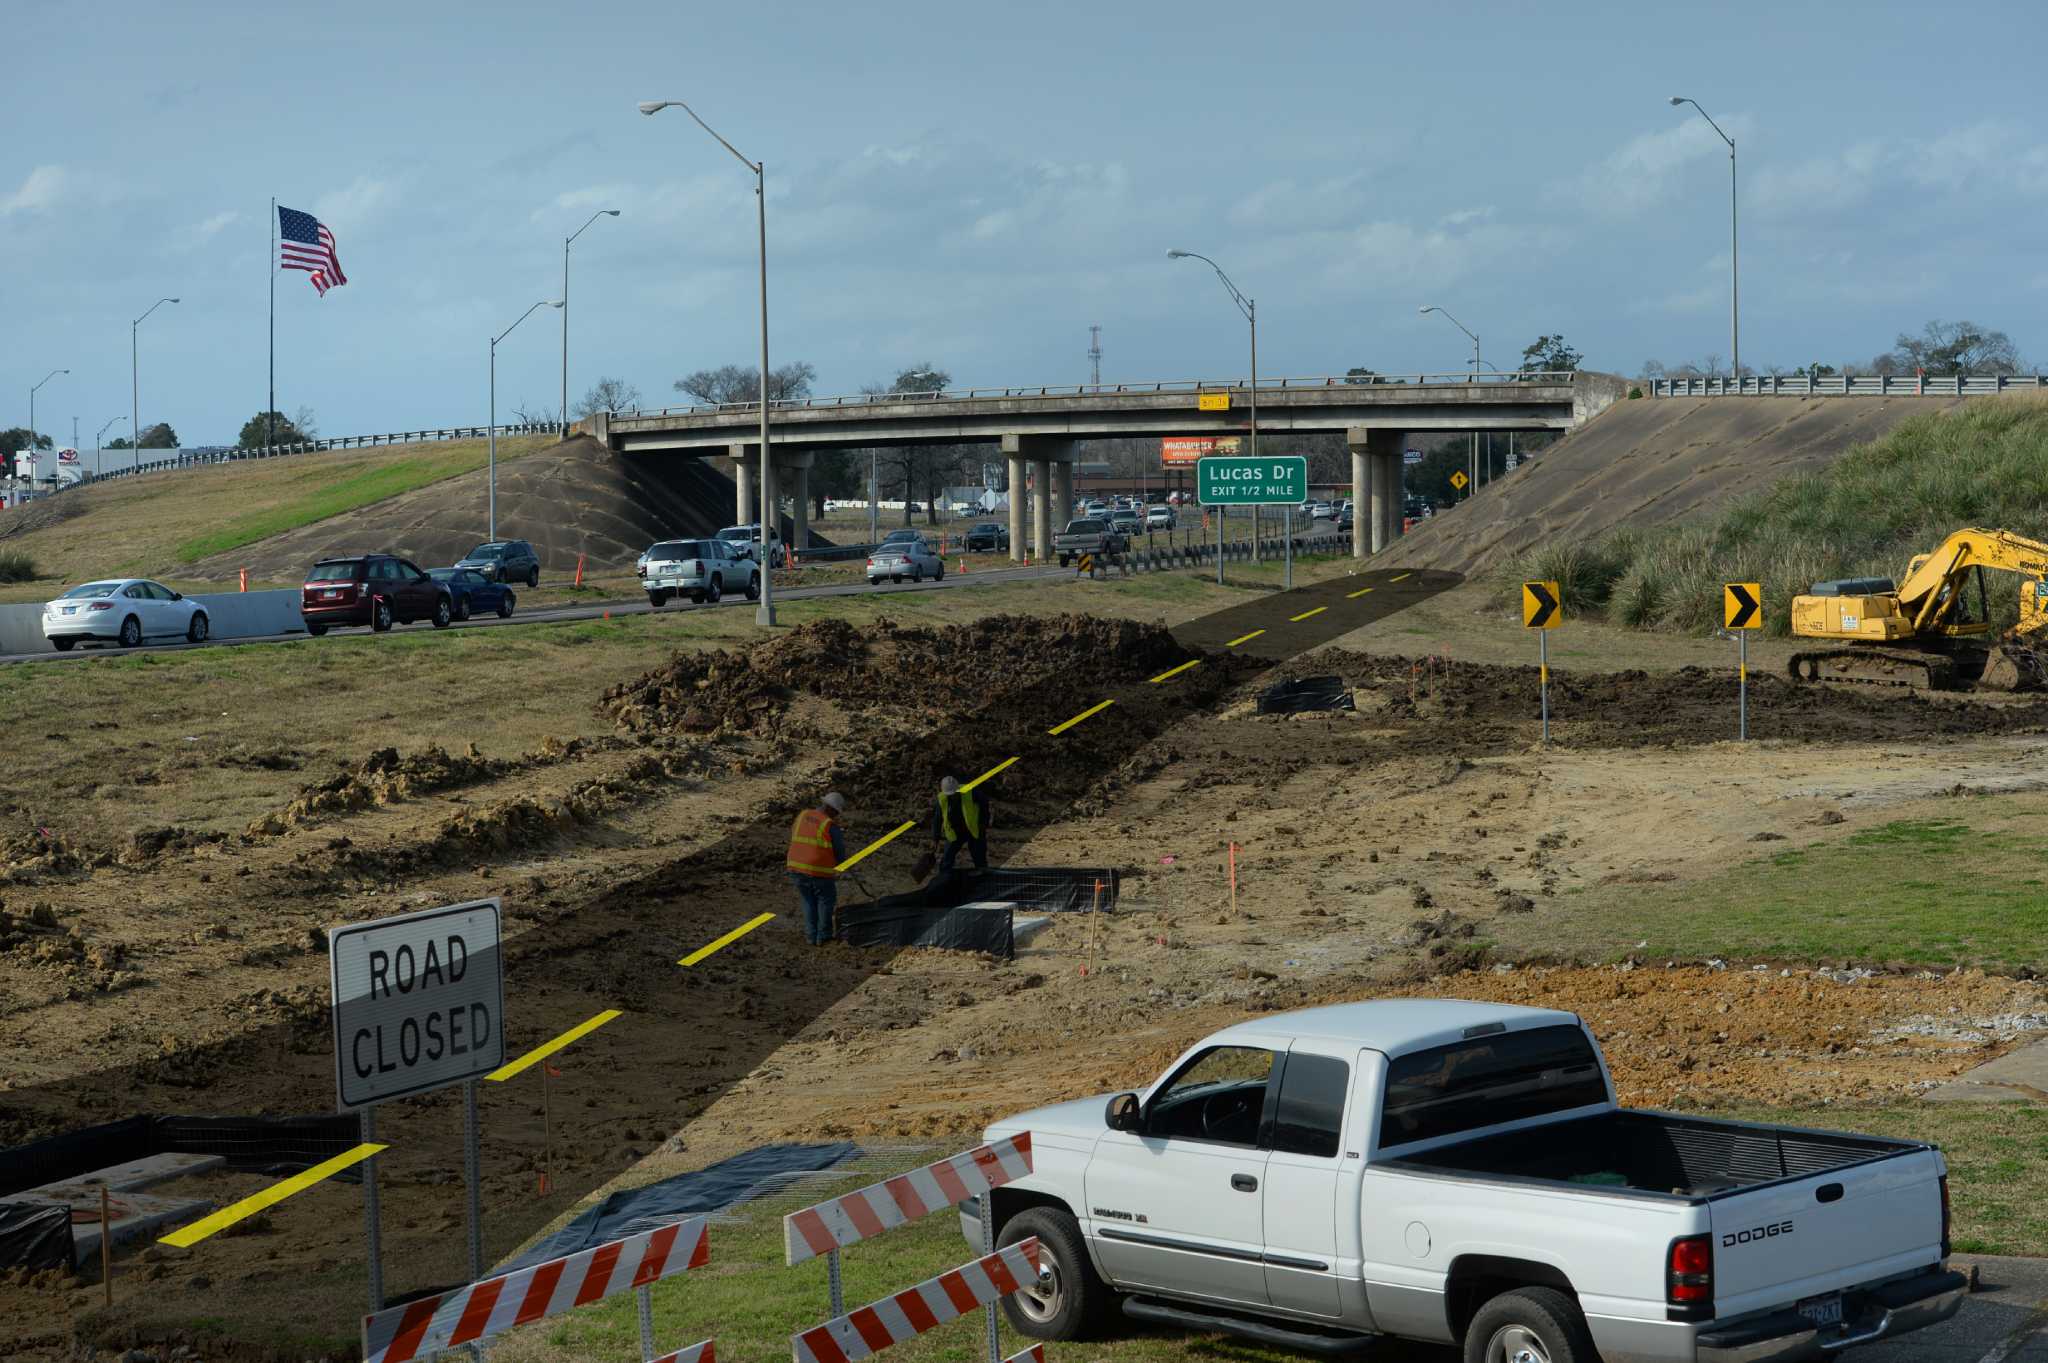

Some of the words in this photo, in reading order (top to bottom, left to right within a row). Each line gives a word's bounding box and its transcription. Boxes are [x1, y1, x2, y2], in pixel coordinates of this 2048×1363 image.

[1209, 466, 1263, 481] Lucas
[1273, 465, 1294, 480] Dr
[1211, 486, 1236, 496] EXIT
[1241, 485, 1260, 496] 1/2
[1266, 485, 1294, 495] MILE
[369, 934, 468, 1000] ROAD
[352, 1001, 491, 1079] CLOSED
[1722, 1220, 1794, 1248] DODGE
